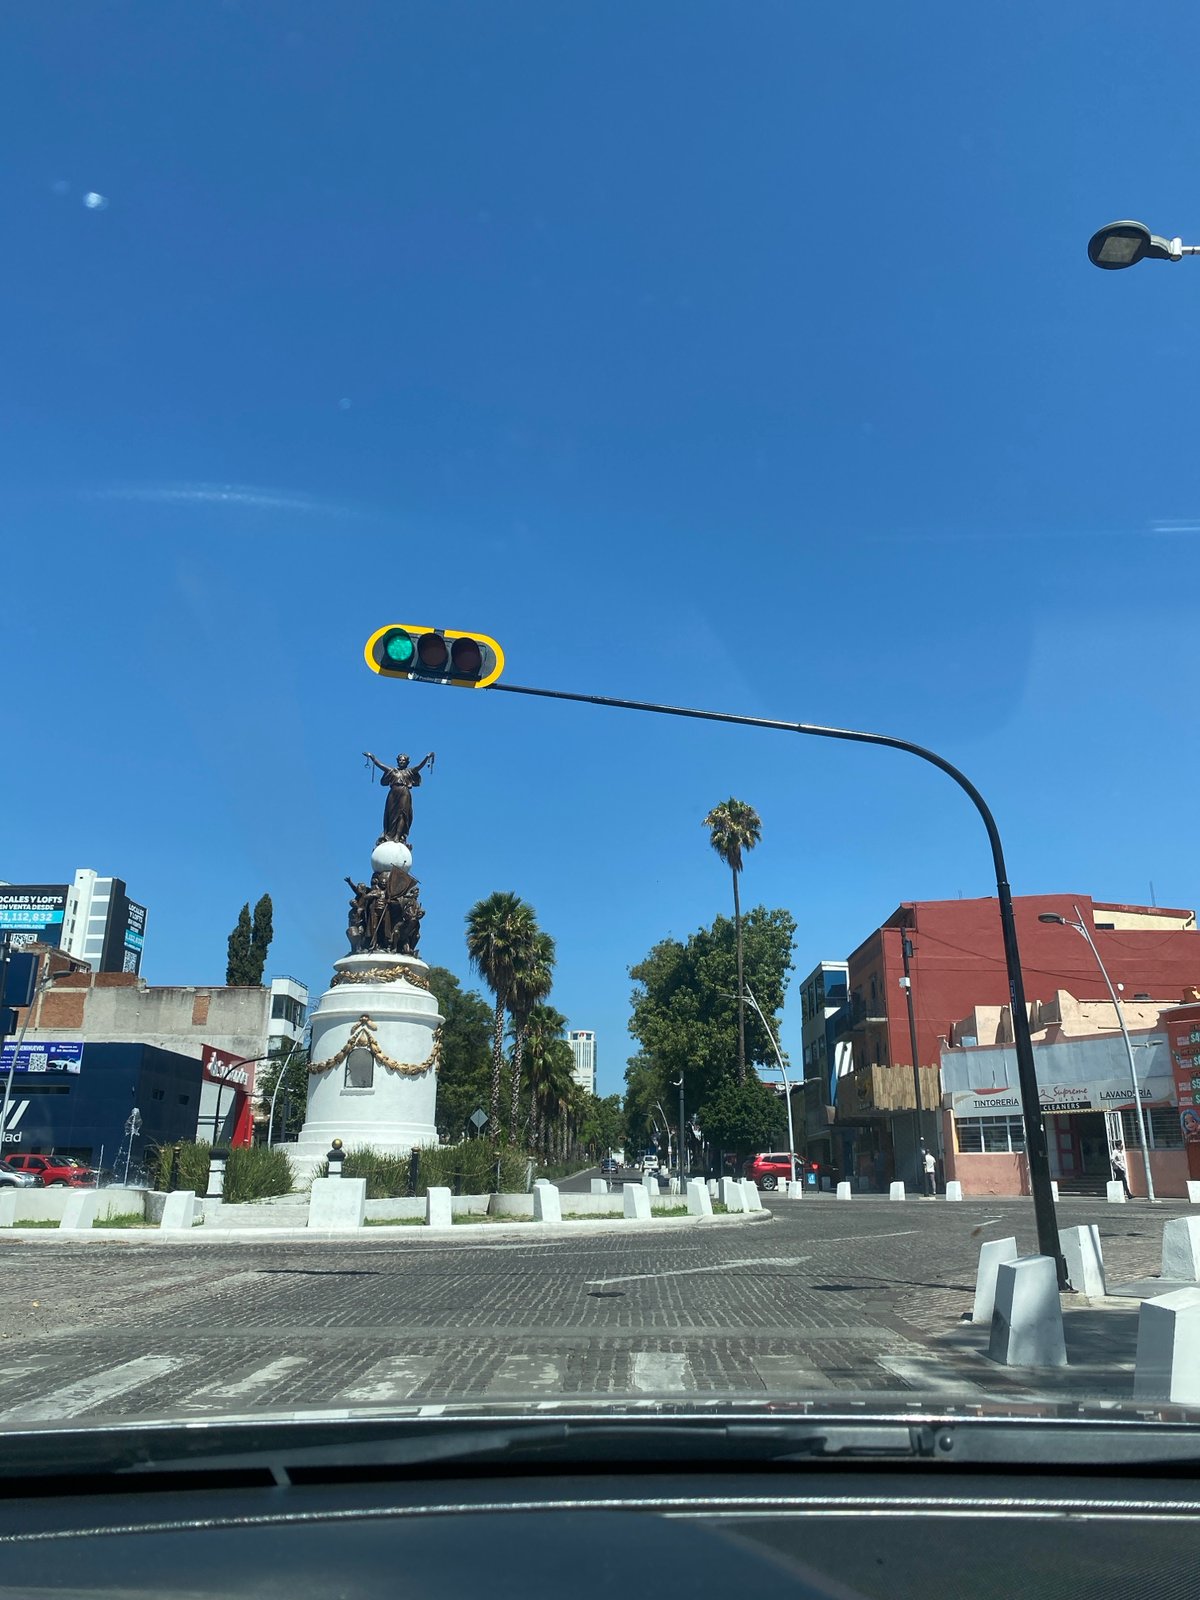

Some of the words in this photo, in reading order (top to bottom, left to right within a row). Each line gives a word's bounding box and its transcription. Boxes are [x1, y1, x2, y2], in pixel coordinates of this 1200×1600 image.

[1053, 1086, 1088, 1097] Supreme
[1099, 1087, 1152, 1099] LAVANDRÍA
[973, 1097, 1019, 1107] TINTORERÍA
[1043, 1102, 1080, 1111] CLEANERS
